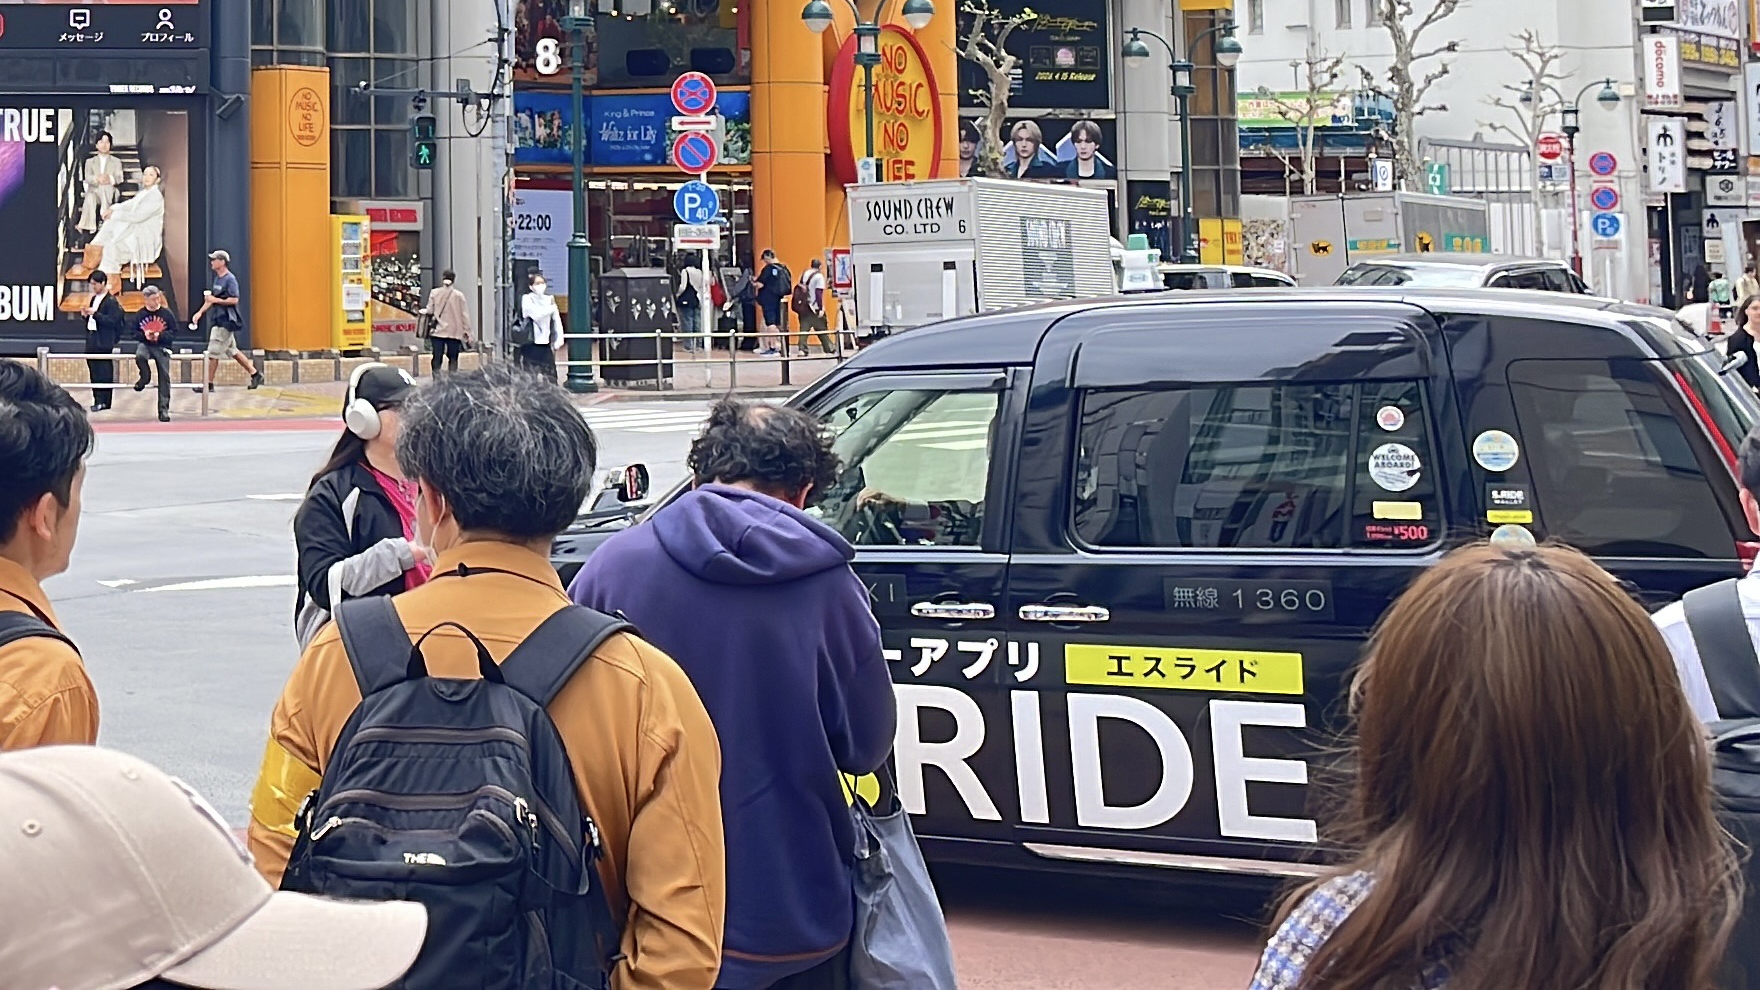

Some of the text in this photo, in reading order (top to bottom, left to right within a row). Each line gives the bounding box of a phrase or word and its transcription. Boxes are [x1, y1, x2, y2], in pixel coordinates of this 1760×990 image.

[58, 31, 105, 43] メッセージ
[141, 31, 195, 43] プロフィール
[882, 44, 908, 76] NO
[1654, 40, 1667, 88] docomo
[883, 121, 909, 152] NO
[684, 192, 702, 220] P
[865, 196, 955, 222] SOUND CREW
[914, 222, 941, 235] LTD
[958, 219, 967, 234] 6
[1373, 453, 1416, 461] WELCOME
[1393, 524, 1429, 541] ¥500
[1172, 585, 1327, 612] 無線 1360
[1106, 653, 1259, 682] エスライド
